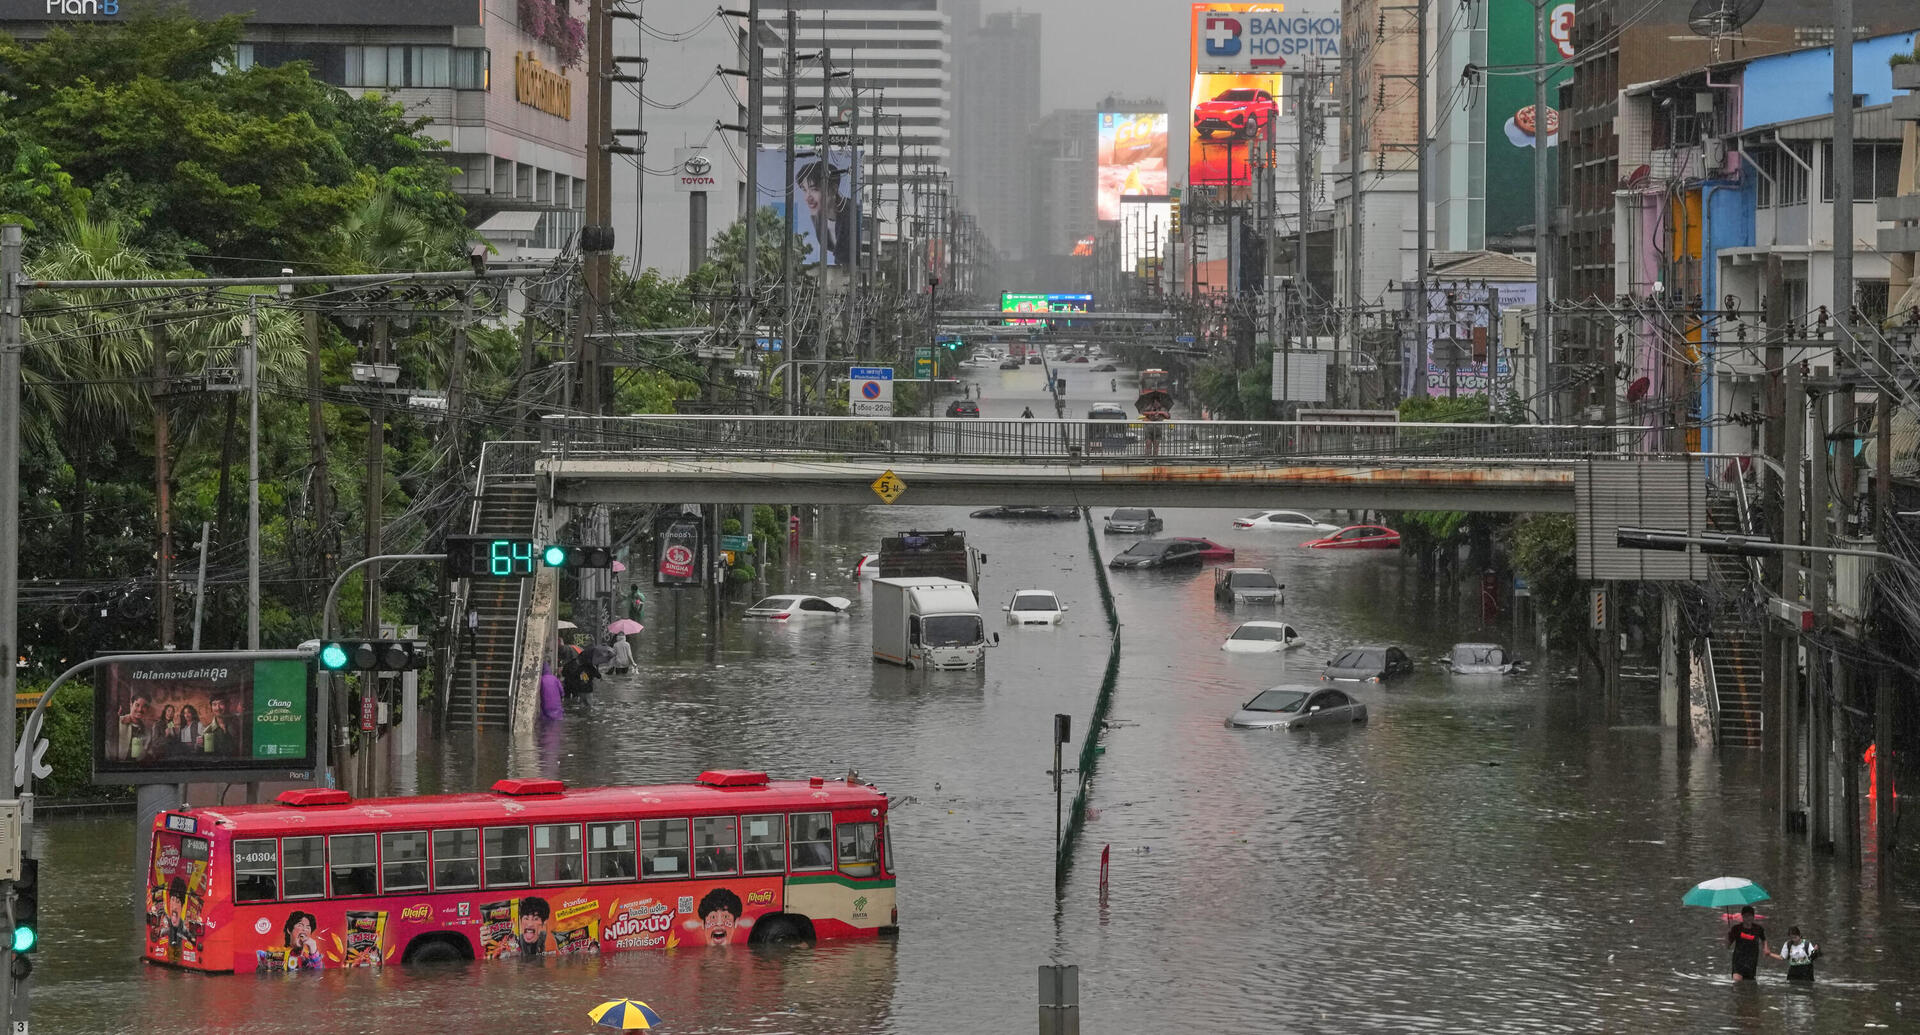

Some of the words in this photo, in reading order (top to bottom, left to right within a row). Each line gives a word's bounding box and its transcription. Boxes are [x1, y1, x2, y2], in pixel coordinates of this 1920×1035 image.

[1250, 38, 1341, 55] HOSPITA
[681, 177, 715, 185] TOYOTA
[881, 481, 889, 493] 5
[492, 541, 532, 575] 64
[665, 562, 689, 572] SINGHA
[267, 698, 292, 709] Chang
[257, 714, 279, 722] COLD
[235, 852, 277, 863] 3-40304
[17, 1021, 25, 1032] 3
